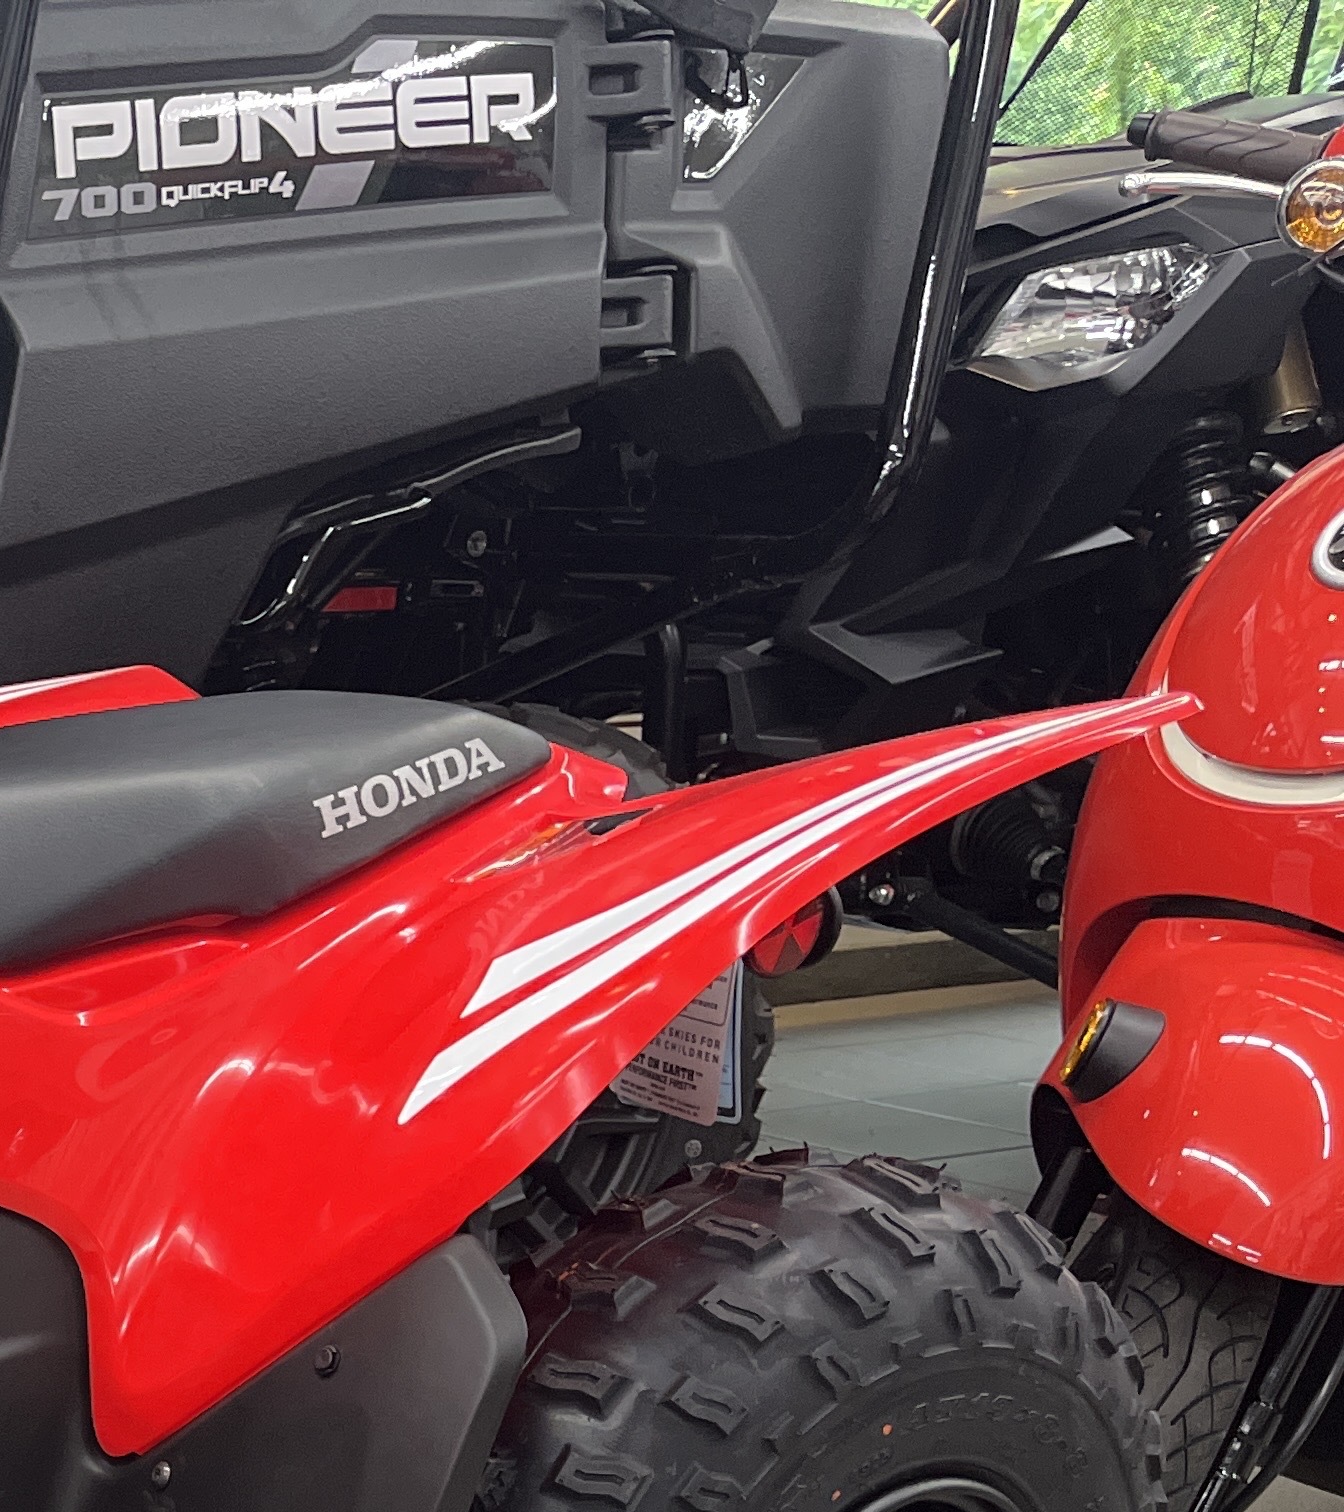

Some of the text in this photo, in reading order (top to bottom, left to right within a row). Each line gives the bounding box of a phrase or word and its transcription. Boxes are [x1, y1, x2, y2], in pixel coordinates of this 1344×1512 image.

[51, 73, 535, 179] PIONEER
[41, 181, 158, 222] 700
[312, 737, 506, 839] HONDA
[664, 1040, 720, 1064] CHILDREN
